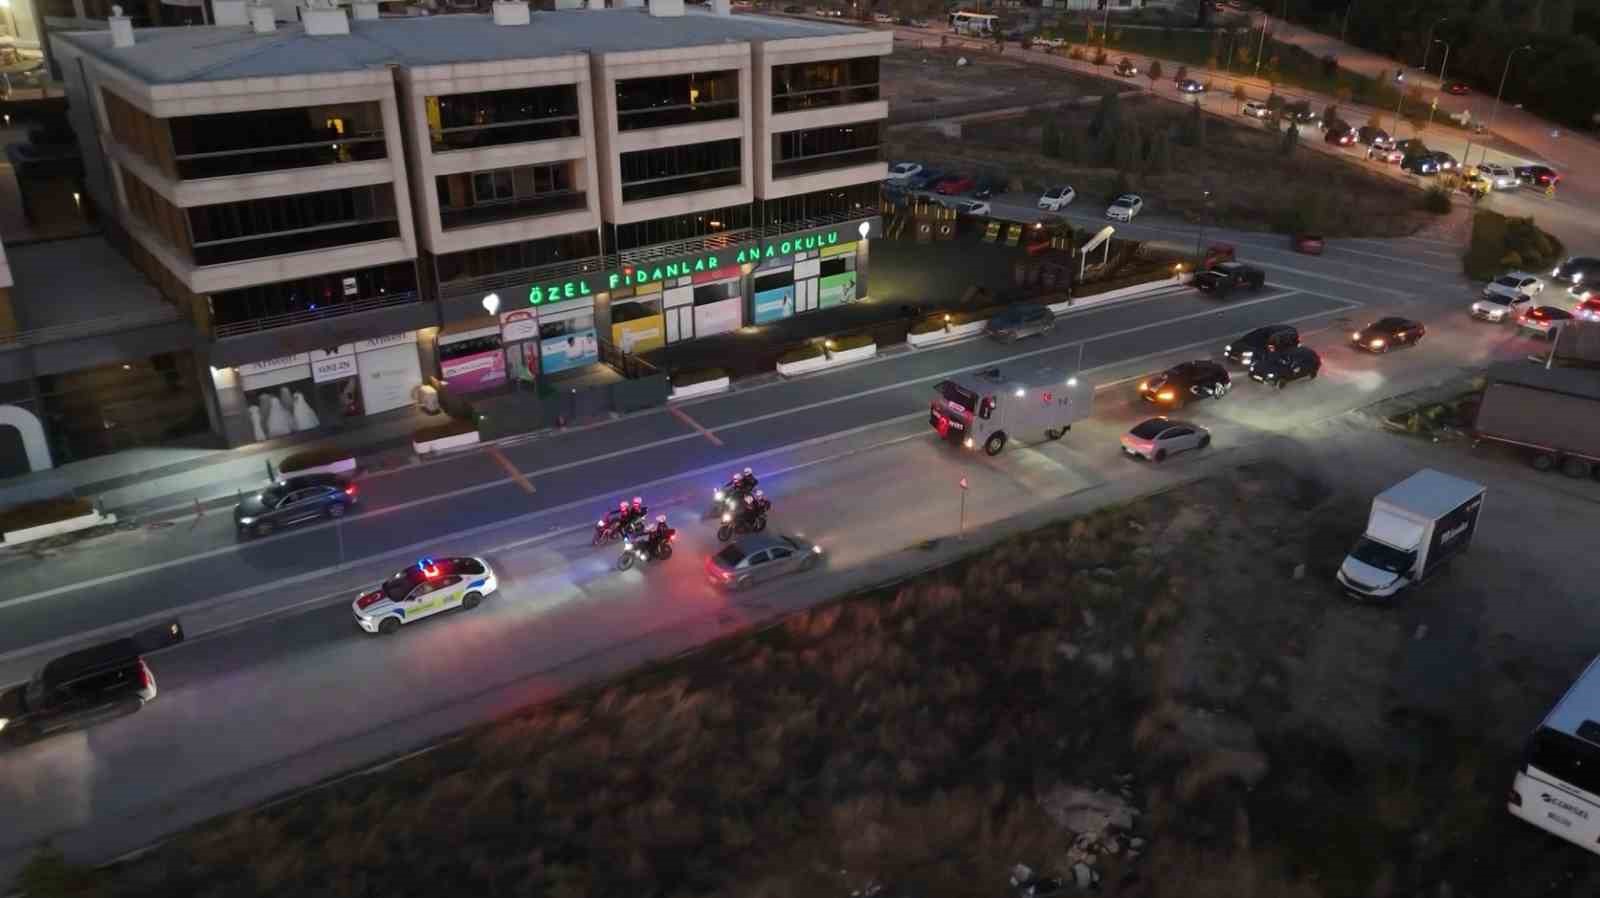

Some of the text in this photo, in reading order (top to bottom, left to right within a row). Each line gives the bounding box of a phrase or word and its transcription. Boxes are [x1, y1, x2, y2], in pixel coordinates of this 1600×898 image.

[529, 232, 838, 304] ÖZEL FİDANLAR ANAOKULU
